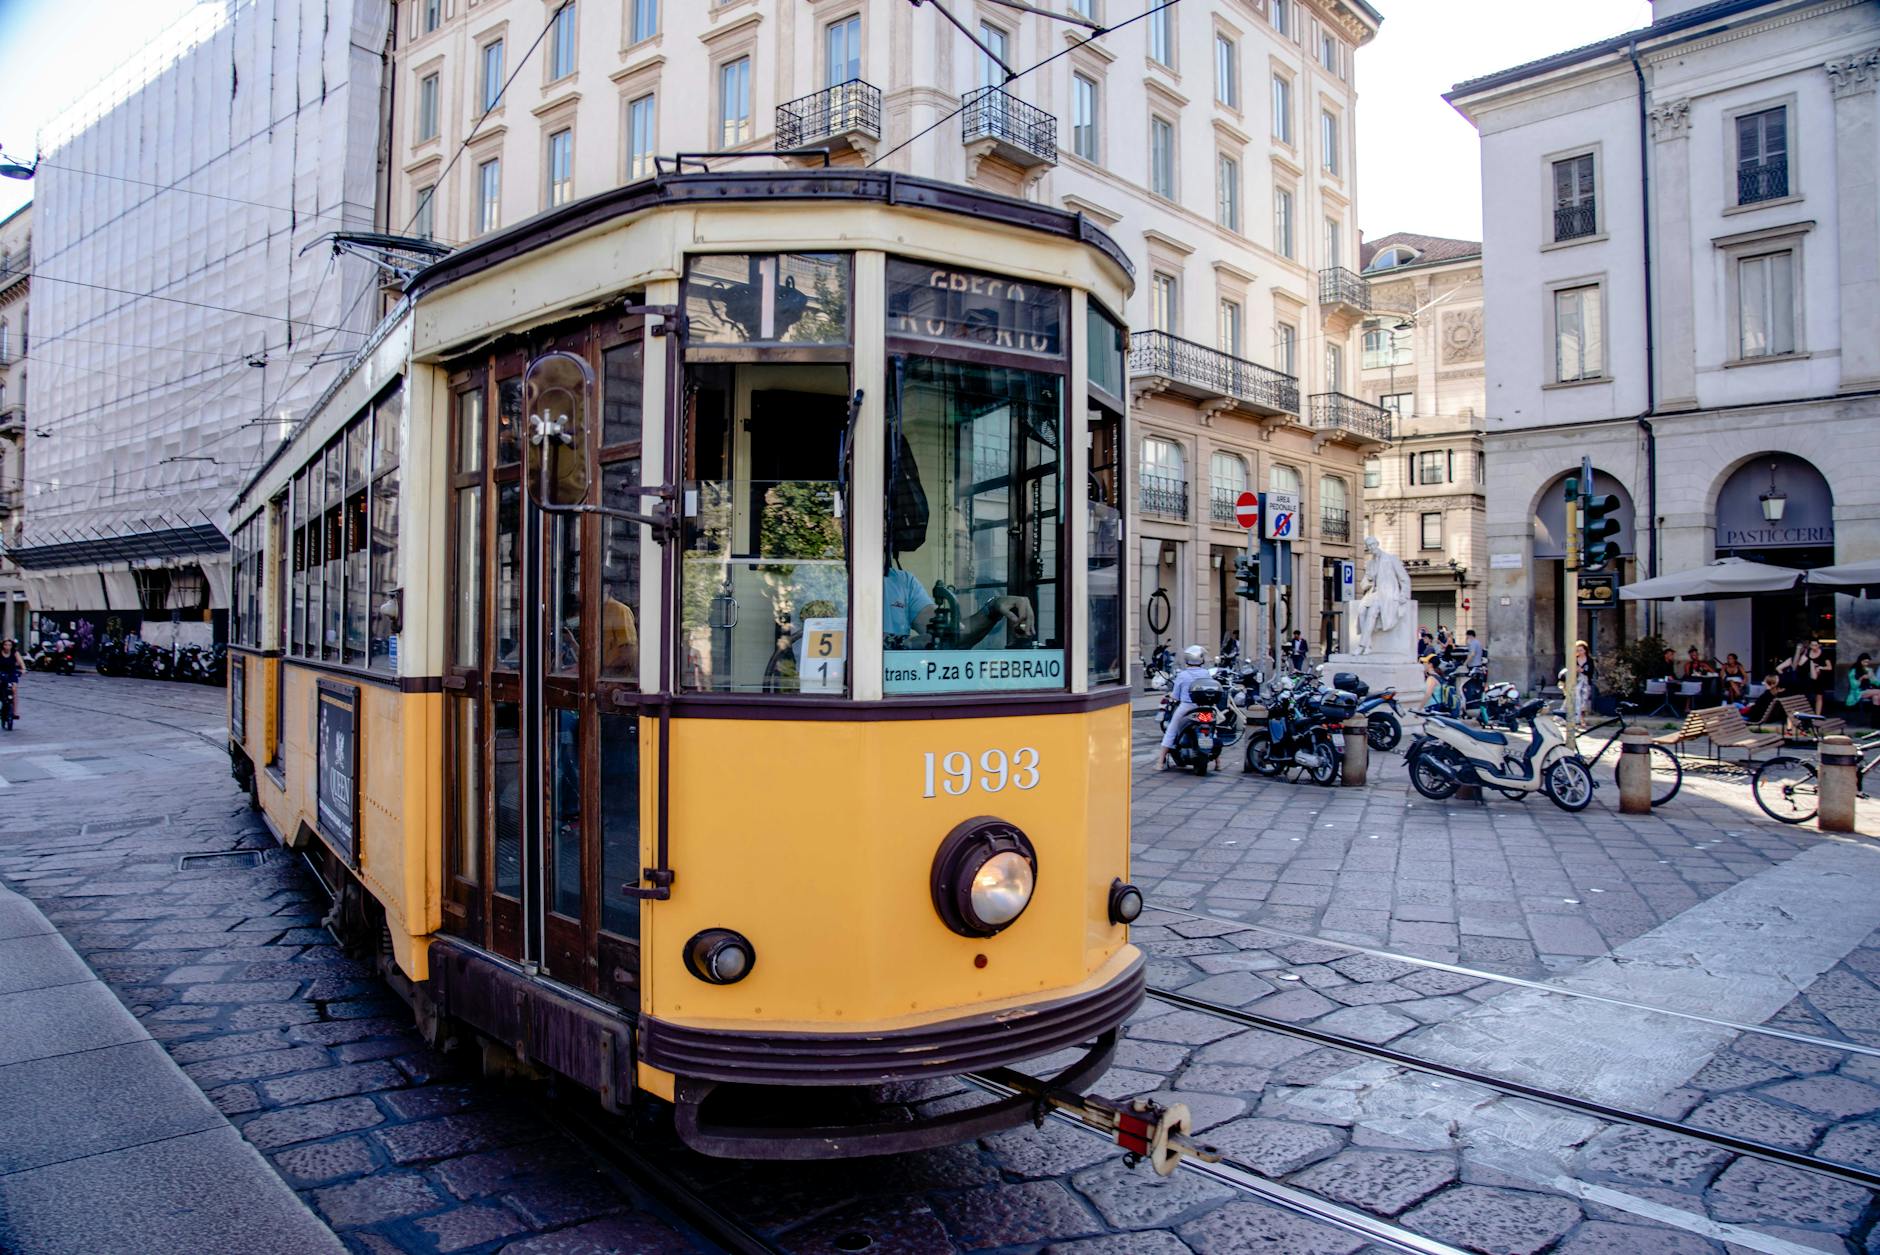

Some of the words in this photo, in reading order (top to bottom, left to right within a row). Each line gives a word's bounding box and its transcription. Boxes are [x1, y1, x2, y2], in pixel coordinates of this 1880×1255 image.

[758, 256, 776, 339] 1
[1276, 495, 1290, 504] AREA
[1345, 567, 1352, 582] P
[819, 633, 833, 657] 5
[817, 661, 828, 687] 1
[885, 667, 921, 682] trans.
[926, 661, 960, 681] P.za
[964, 661, 975, 680] 6
[979, 659, 1061, 679] FEBBRAIO
[922, 746, 1040, 799] 1993
[330, 766, 350, 805] QUEEN
